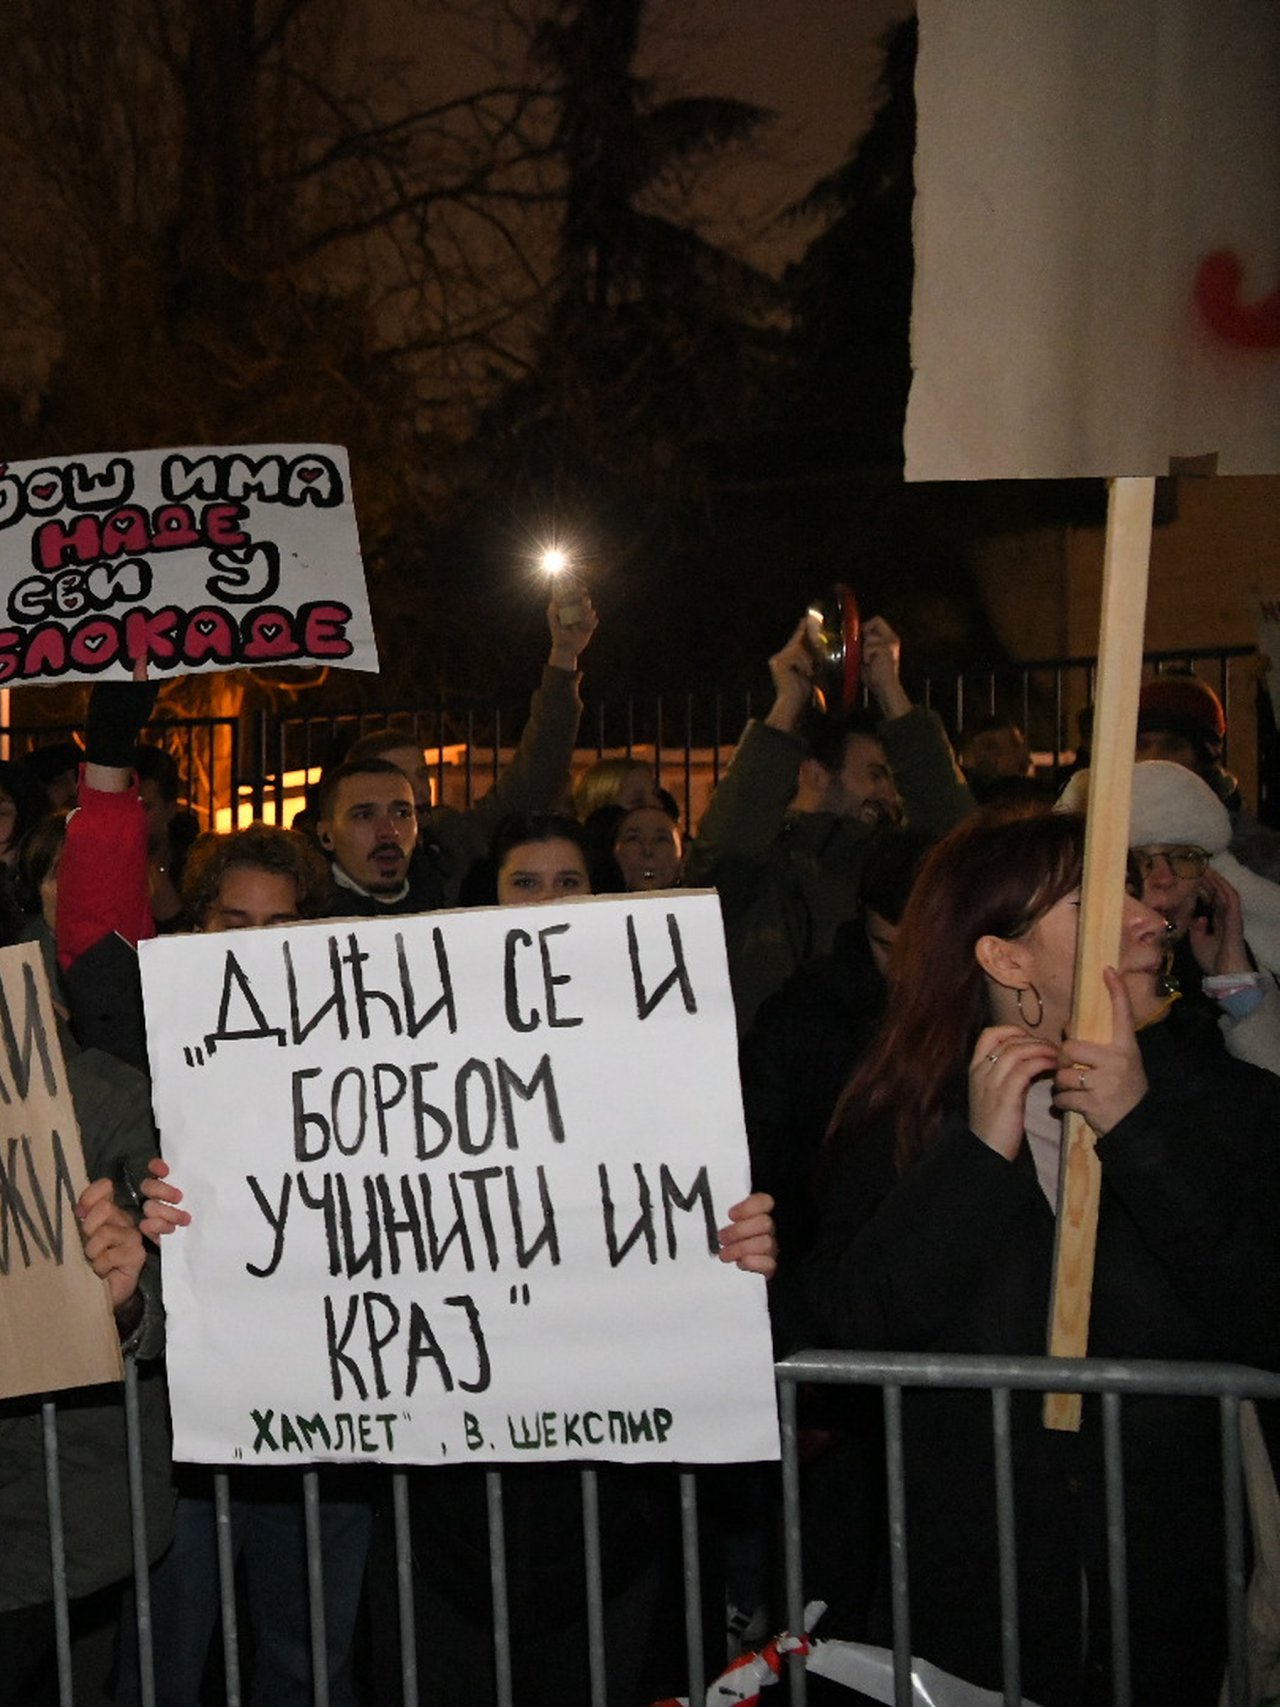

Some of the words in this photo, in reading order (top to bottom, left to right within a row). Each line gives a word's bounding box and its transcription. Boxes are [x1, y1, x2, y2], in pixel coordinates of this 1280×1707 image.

[161, 453, 344, 507] ИМА
[32, 502, 251, 574] НАДЕ
[6, 557, 153, 624] СВИ
[205, 541, 281, 603] У
[504, 923, 583, 1033] СЕ
[626, 913, 697, 1020] И
[291, 1054, 565, 1162] БОРБОМ
[246, 1165, 561, 1279] УЧИНИТИ
[599, 1163, 721, 1267] ИМ
[507, 1407, 674, 1450] ШЕКСПИР
